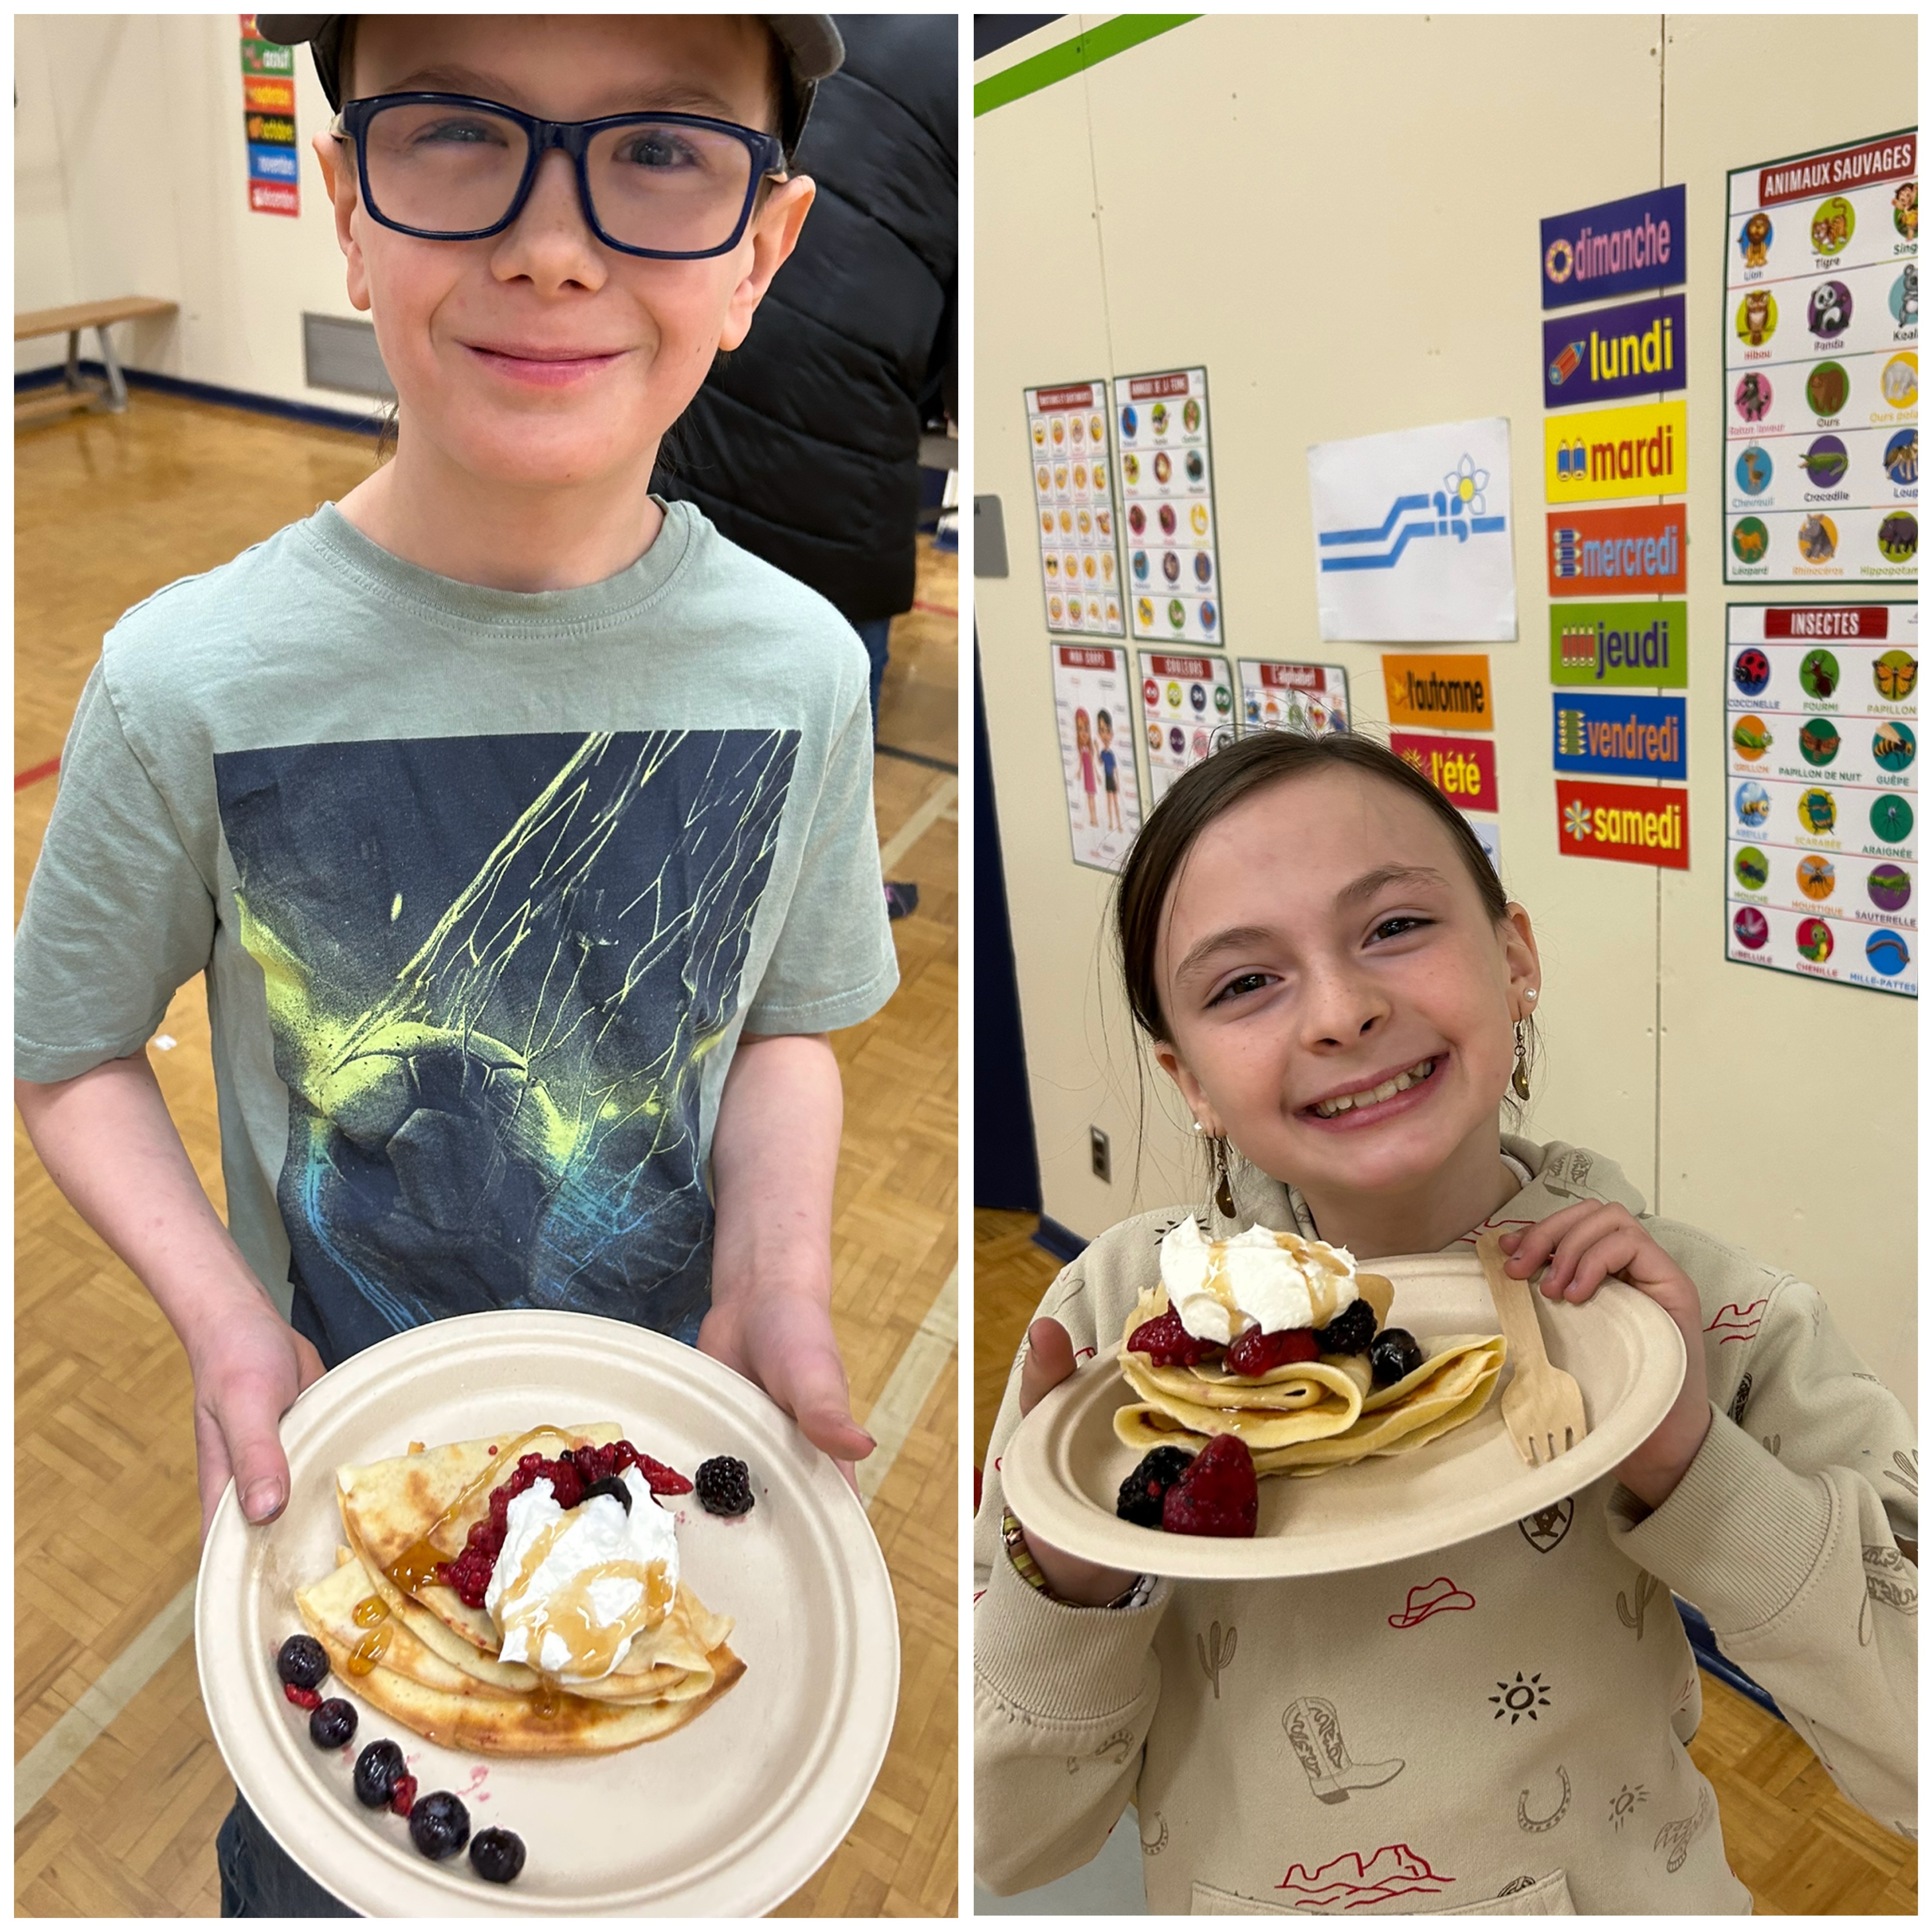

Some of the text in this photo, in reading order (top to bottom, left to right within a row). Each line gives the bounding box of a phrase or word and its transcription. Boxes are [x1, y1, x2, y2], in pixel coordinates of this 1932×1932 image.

[1764, 143, 1911, 198] ANIMAUX SAUVAGES
[1574, 213, 1671, 282] dimanche
[1893, 244, 1918, 256] Sing
[1815, 257, 1841, 269] Tigre
[1744, 270, 1763, 281] Lion
[1893, 330, 1918, 341] Koal
[1591, 317, 1673, 382] lundi
[1814, 340, 1845, 351] Panda
[1745, 350, 1772, 360] Hibou
[1817, 418, 1840, 427] Ours
[1870, 412, 1893, 423] Ours
[1730, 424, 1785, 435] Raton laveur
[1591, 424, 1673, 482] mardi
[1732, 497, 1775, 508] Chevreuil
[1804, 492, 1850, 502] Crocodile
[1582, 526, 1678, 577] mercredi
[1792, 566, 1844, 576] Rhinocéros
[1791, 612, 1860, 635] INSECTES
[1596, 621, 1668, 679] jeudi
[1165, 657, 1204, 677] COULEURS
[1407, 670, 1484, 713] l'automne
[1728, 699, 1780, 710] COCCINELLE
[1804, 702, 1838, 711] FOURMI
[1867, 705, 1916, 715] PAPILLON
[1588, 715, 1678, 762] vendredi
[1432, 750, 1481, 796] l'été
[1733, 764, 1769, 773] GRILLON
[1779, 767, 1861, 781] PAPILLON DE NUIT
[1876, 774, 1910, 786] GUÊPE
[1594, 805, 1681, 850] samedi
[1736, 829, 1768, 840] ABEILLE
[1795, 837, 1842, 850] SCARABÉE
[1862, 845, 1913, 859] ARAIGNÉE
[1734, 891, 1768, 904] MOUCHE
[1791, 900, 1844, 916] MOUSTIQUE
[1855, 911, 1916, 927] SAUTERELLE
[1732, 950, 1772, 965] LIBELLULE
[1796, 962, 1838, 977] CHENILLE
[1850, 973, 1916, 993] MILLE-PATTES
